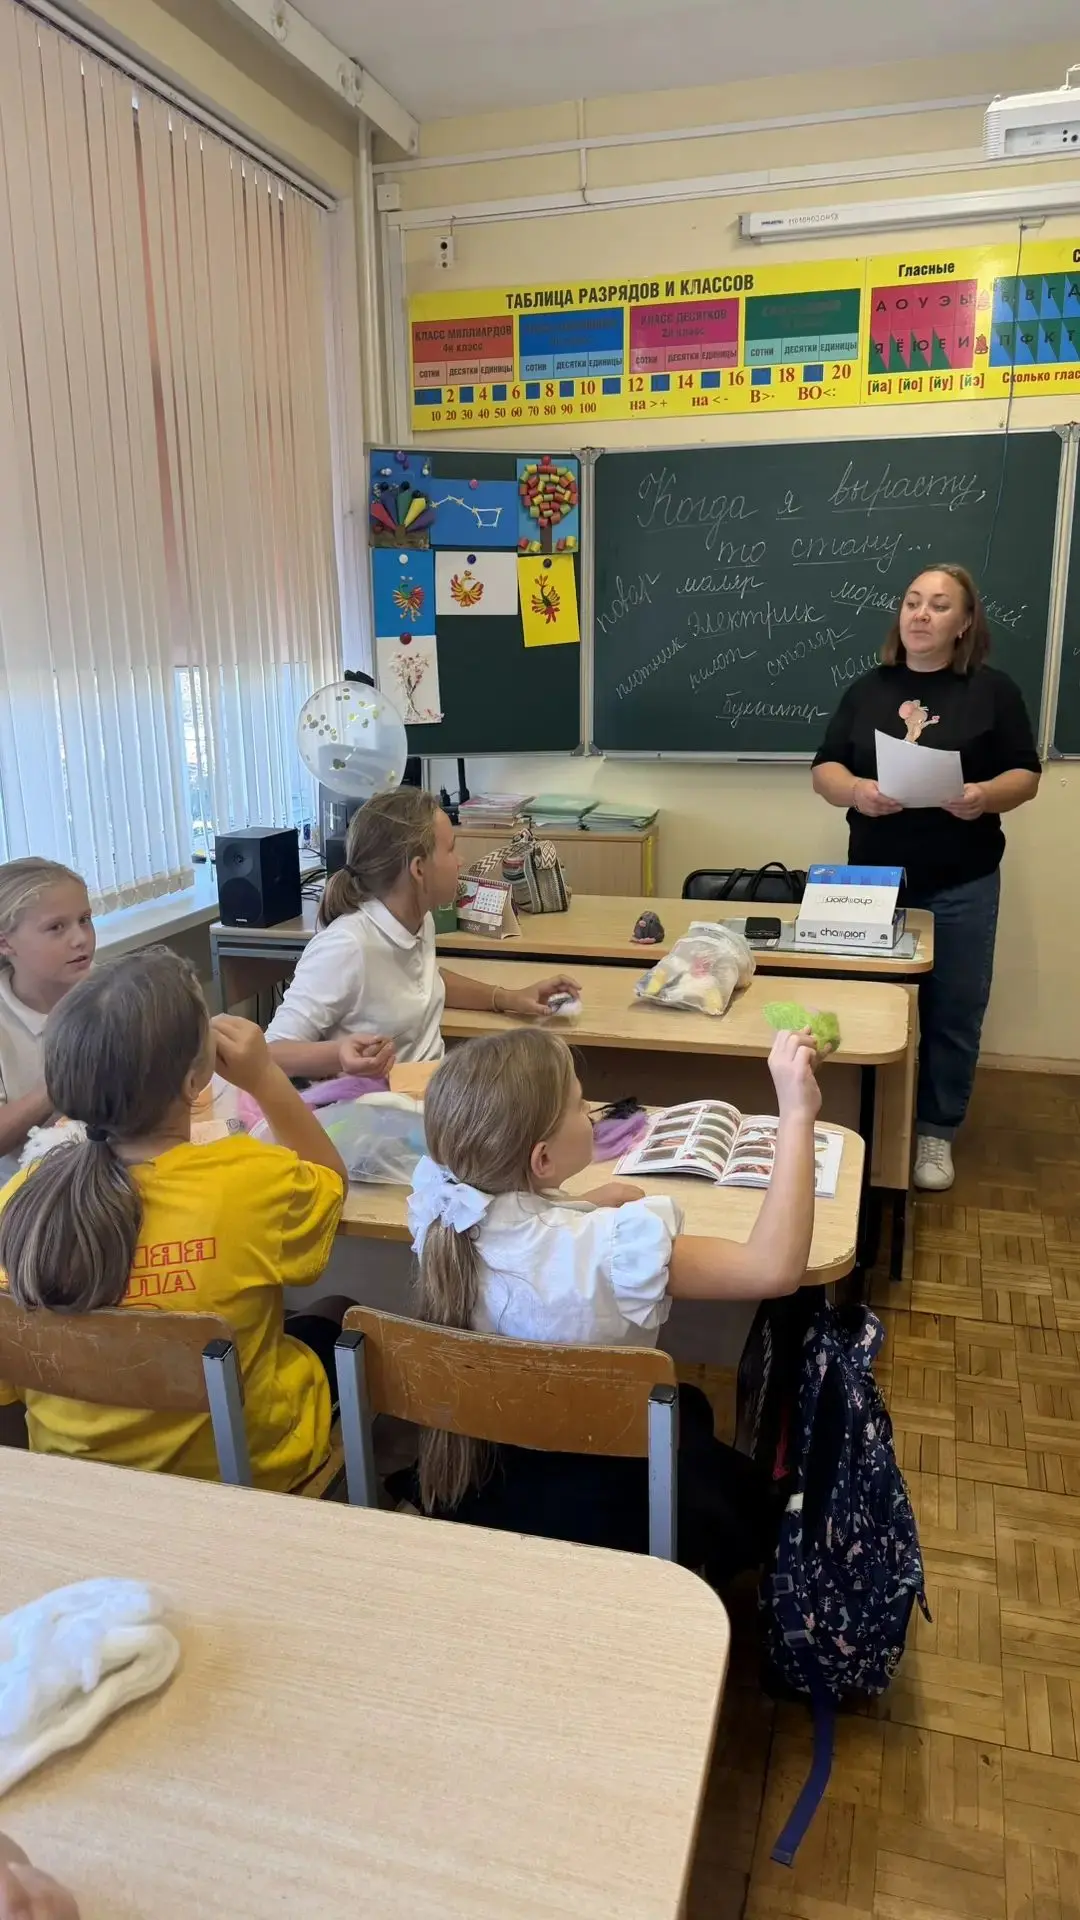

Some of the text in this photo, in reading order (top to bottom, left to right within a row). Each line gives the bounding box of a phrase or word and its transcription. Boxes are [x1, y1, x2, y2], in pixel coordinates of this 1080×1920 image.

[898, 262, 955, 277] Гласные
[506, 274, 754, 309] ТАБЛИЦА РАЗРЯДОВ И КЛАССОВ
[1025, 289, 1035, 301] В
[1048, 287, 1056, 299] Г
[876, 300, 887, 312] А
[895, 298, 909, 310] О
[918, 297, 929, 308] У
[939, 295, 951, 306] Э
[415, 330, 446, 341] КЛАСС
[820, 341, 857, 353] ЕДИНИЦЫ
[913, 340, 929, 351] Ю
[938, 338, 946, 349] Е
[958, 336, 970, 348] И
[701, 349, 737, 360] ЕДИНИЦЫ
[750, 347, 774, 357] СОТНИ
[784, 344, 818, 355] ДЕСЯТКИ
[874, 343, 884, 354] Я
[588, 358, 622, 368] ЕДИНИЦЫ
[635, 355, 657, 364] СОТНИ
[668, 351, 699, 363] ДЕСЯТКИ
[480, 365, 513, 375] ЕДИНИЦЫ
[525, 363, 547, 372] СОТНИ
[556, 360, 587, 370] ДЕСЯТКИ
[419, 370, 440, 378] СОТНИ
[449, 367, 478, 377] ДЕСЯТКИ
[1002, 371, 1050, 384] Сколько
[446, 364, 851, 403] 2 4 6 8 10 12 14 16 18 20
[867, 378, 892, 395] [йа]
[899, 377, 923, 394] [йо]
[929, 375, 953, 392] [йу]
[629, 399, 646, 410] на
[692, 395, 709, 406] на
[431, 403, 597, 422] 10 20 30 40 50 60 70 80 90 100
[634, 467, 759, 550] Когда
[776, 490, 802, 514] я
[717, 541, 766, 563] то
[676, 574, 765, 600] маляр
[597, 572, 662, 633] повар
[767, 627, 849, 676] столяр
[616, 637, 687, 700] плотник
[689, 648, 757, 689] пилот
[720, 691, 830, 729] бухгалтер
